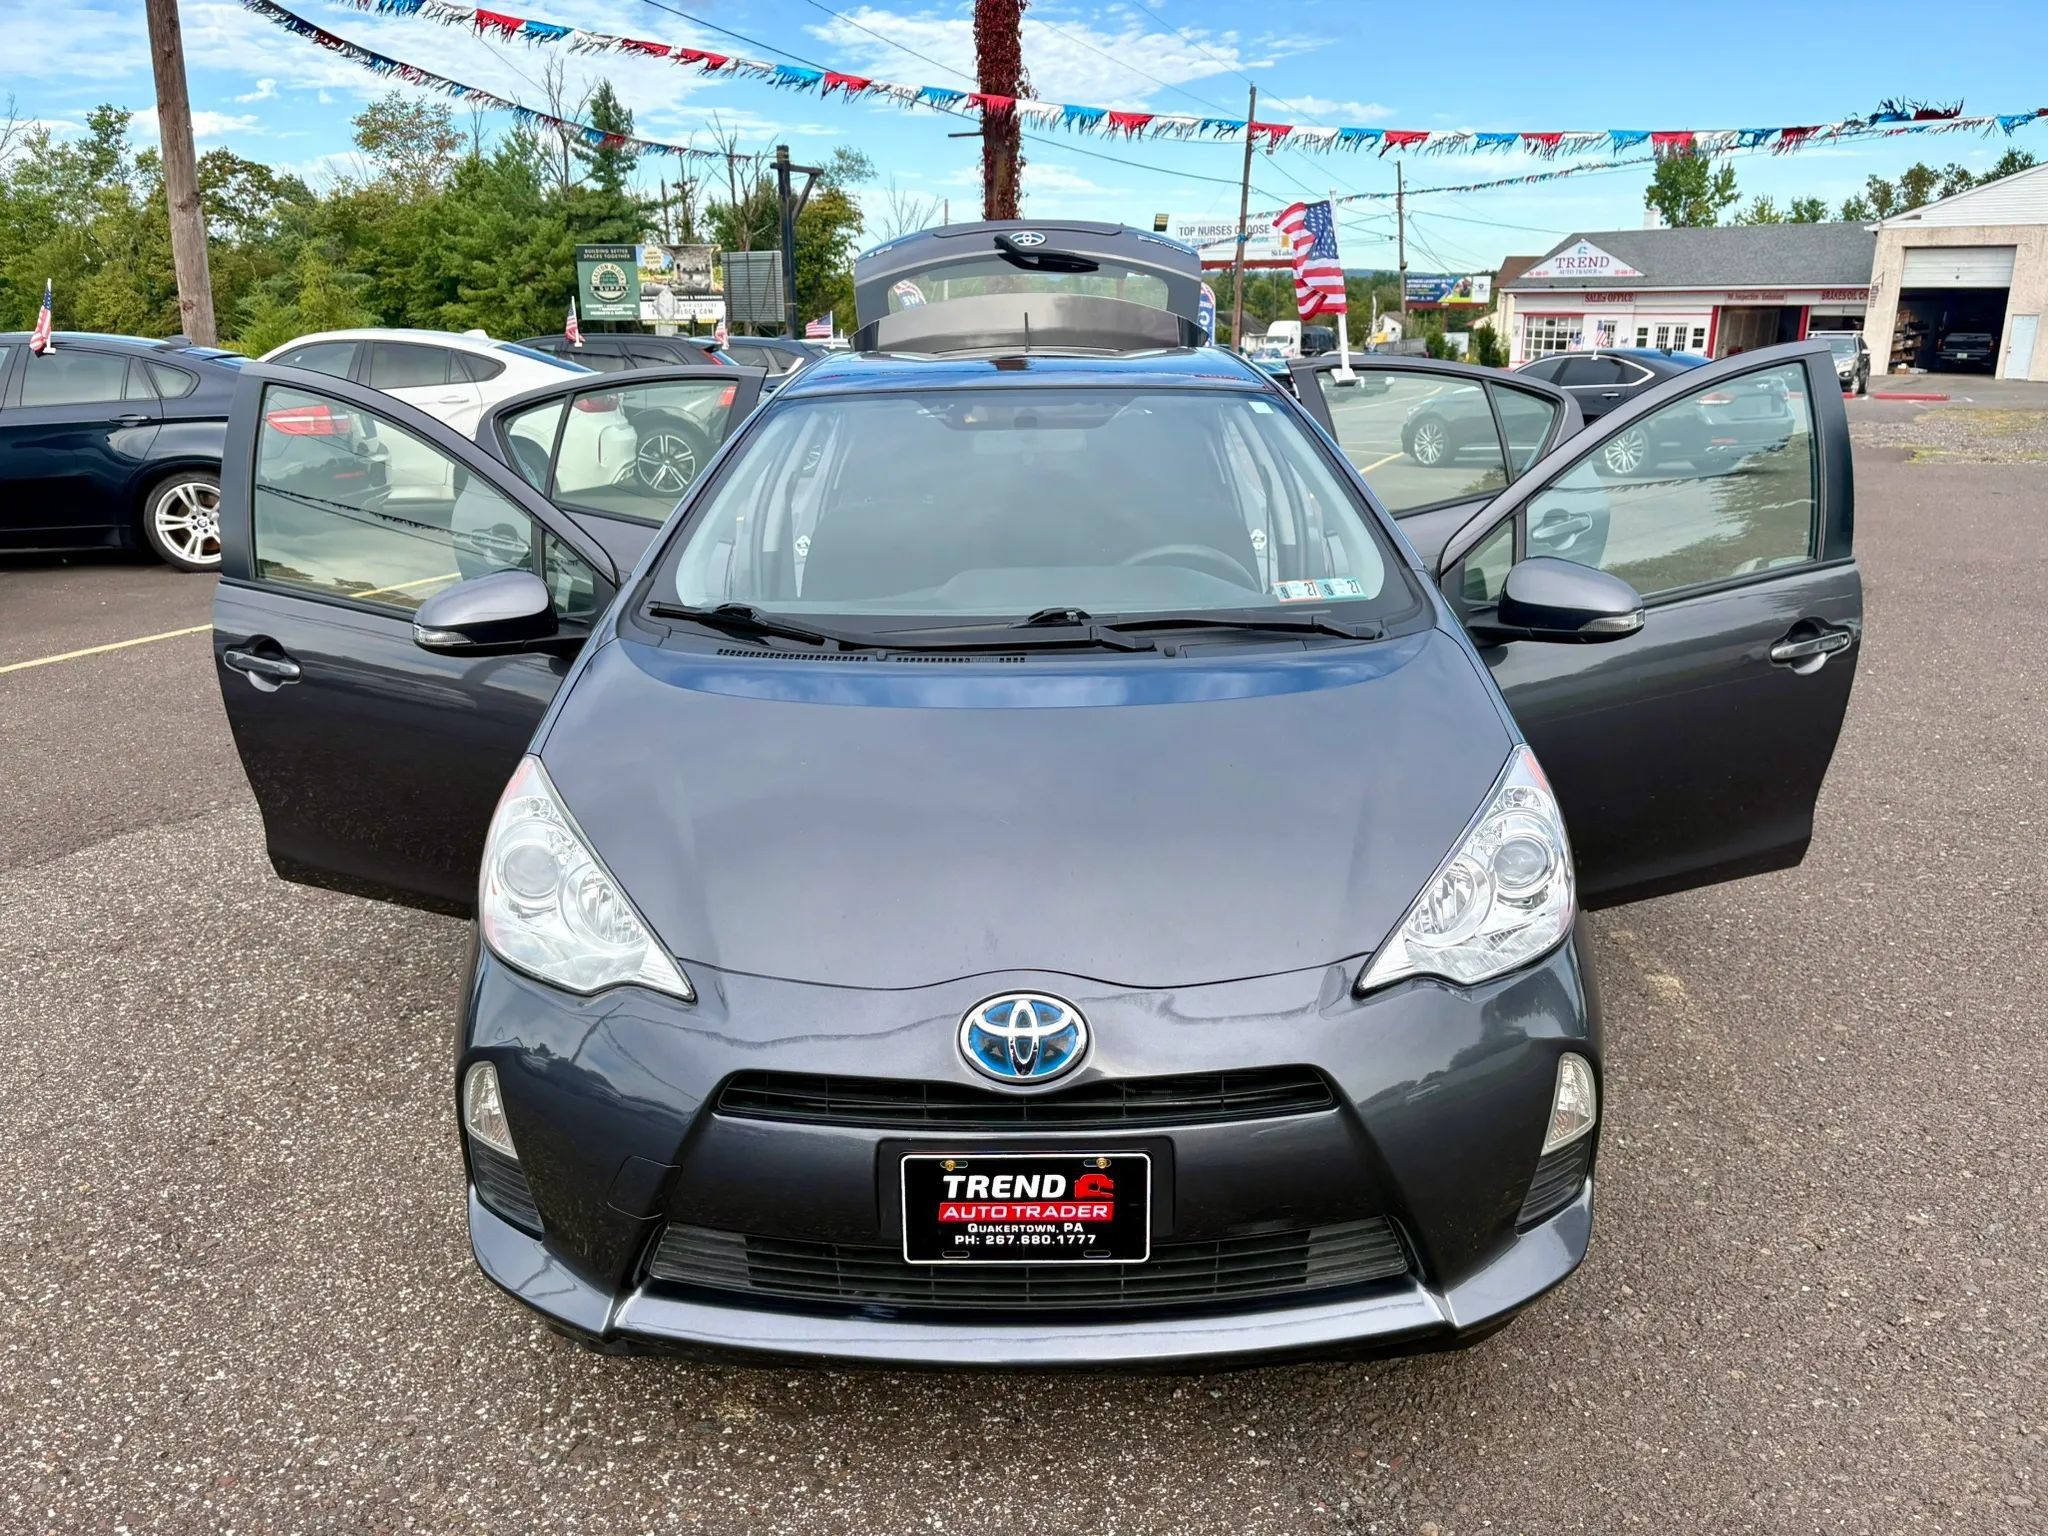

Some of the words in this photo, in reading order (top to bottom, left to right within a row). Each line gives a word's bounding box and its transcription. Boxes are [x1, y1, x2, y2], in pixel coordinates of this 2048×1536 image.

[1179, 226, 1196, 236] TOP
[1198, 225, 1232, 236] NURSES
[1235, 224, 1270, 235] COOSE
[1555, 256, 1610, 269] TREND
[1607, 292, 1633, 302] OFFICE
[943, 1174, 1066, 1199] TREND
[943, 1206, 1007, 1219] AUTO
[1012, 1205, 1108, 1218] TRADER
[1063, 1222, 1084, 1233] PA
[955, 1235, 980, 1245] PH:
[985, 1235, 1097, 1245] 267.680.1777
